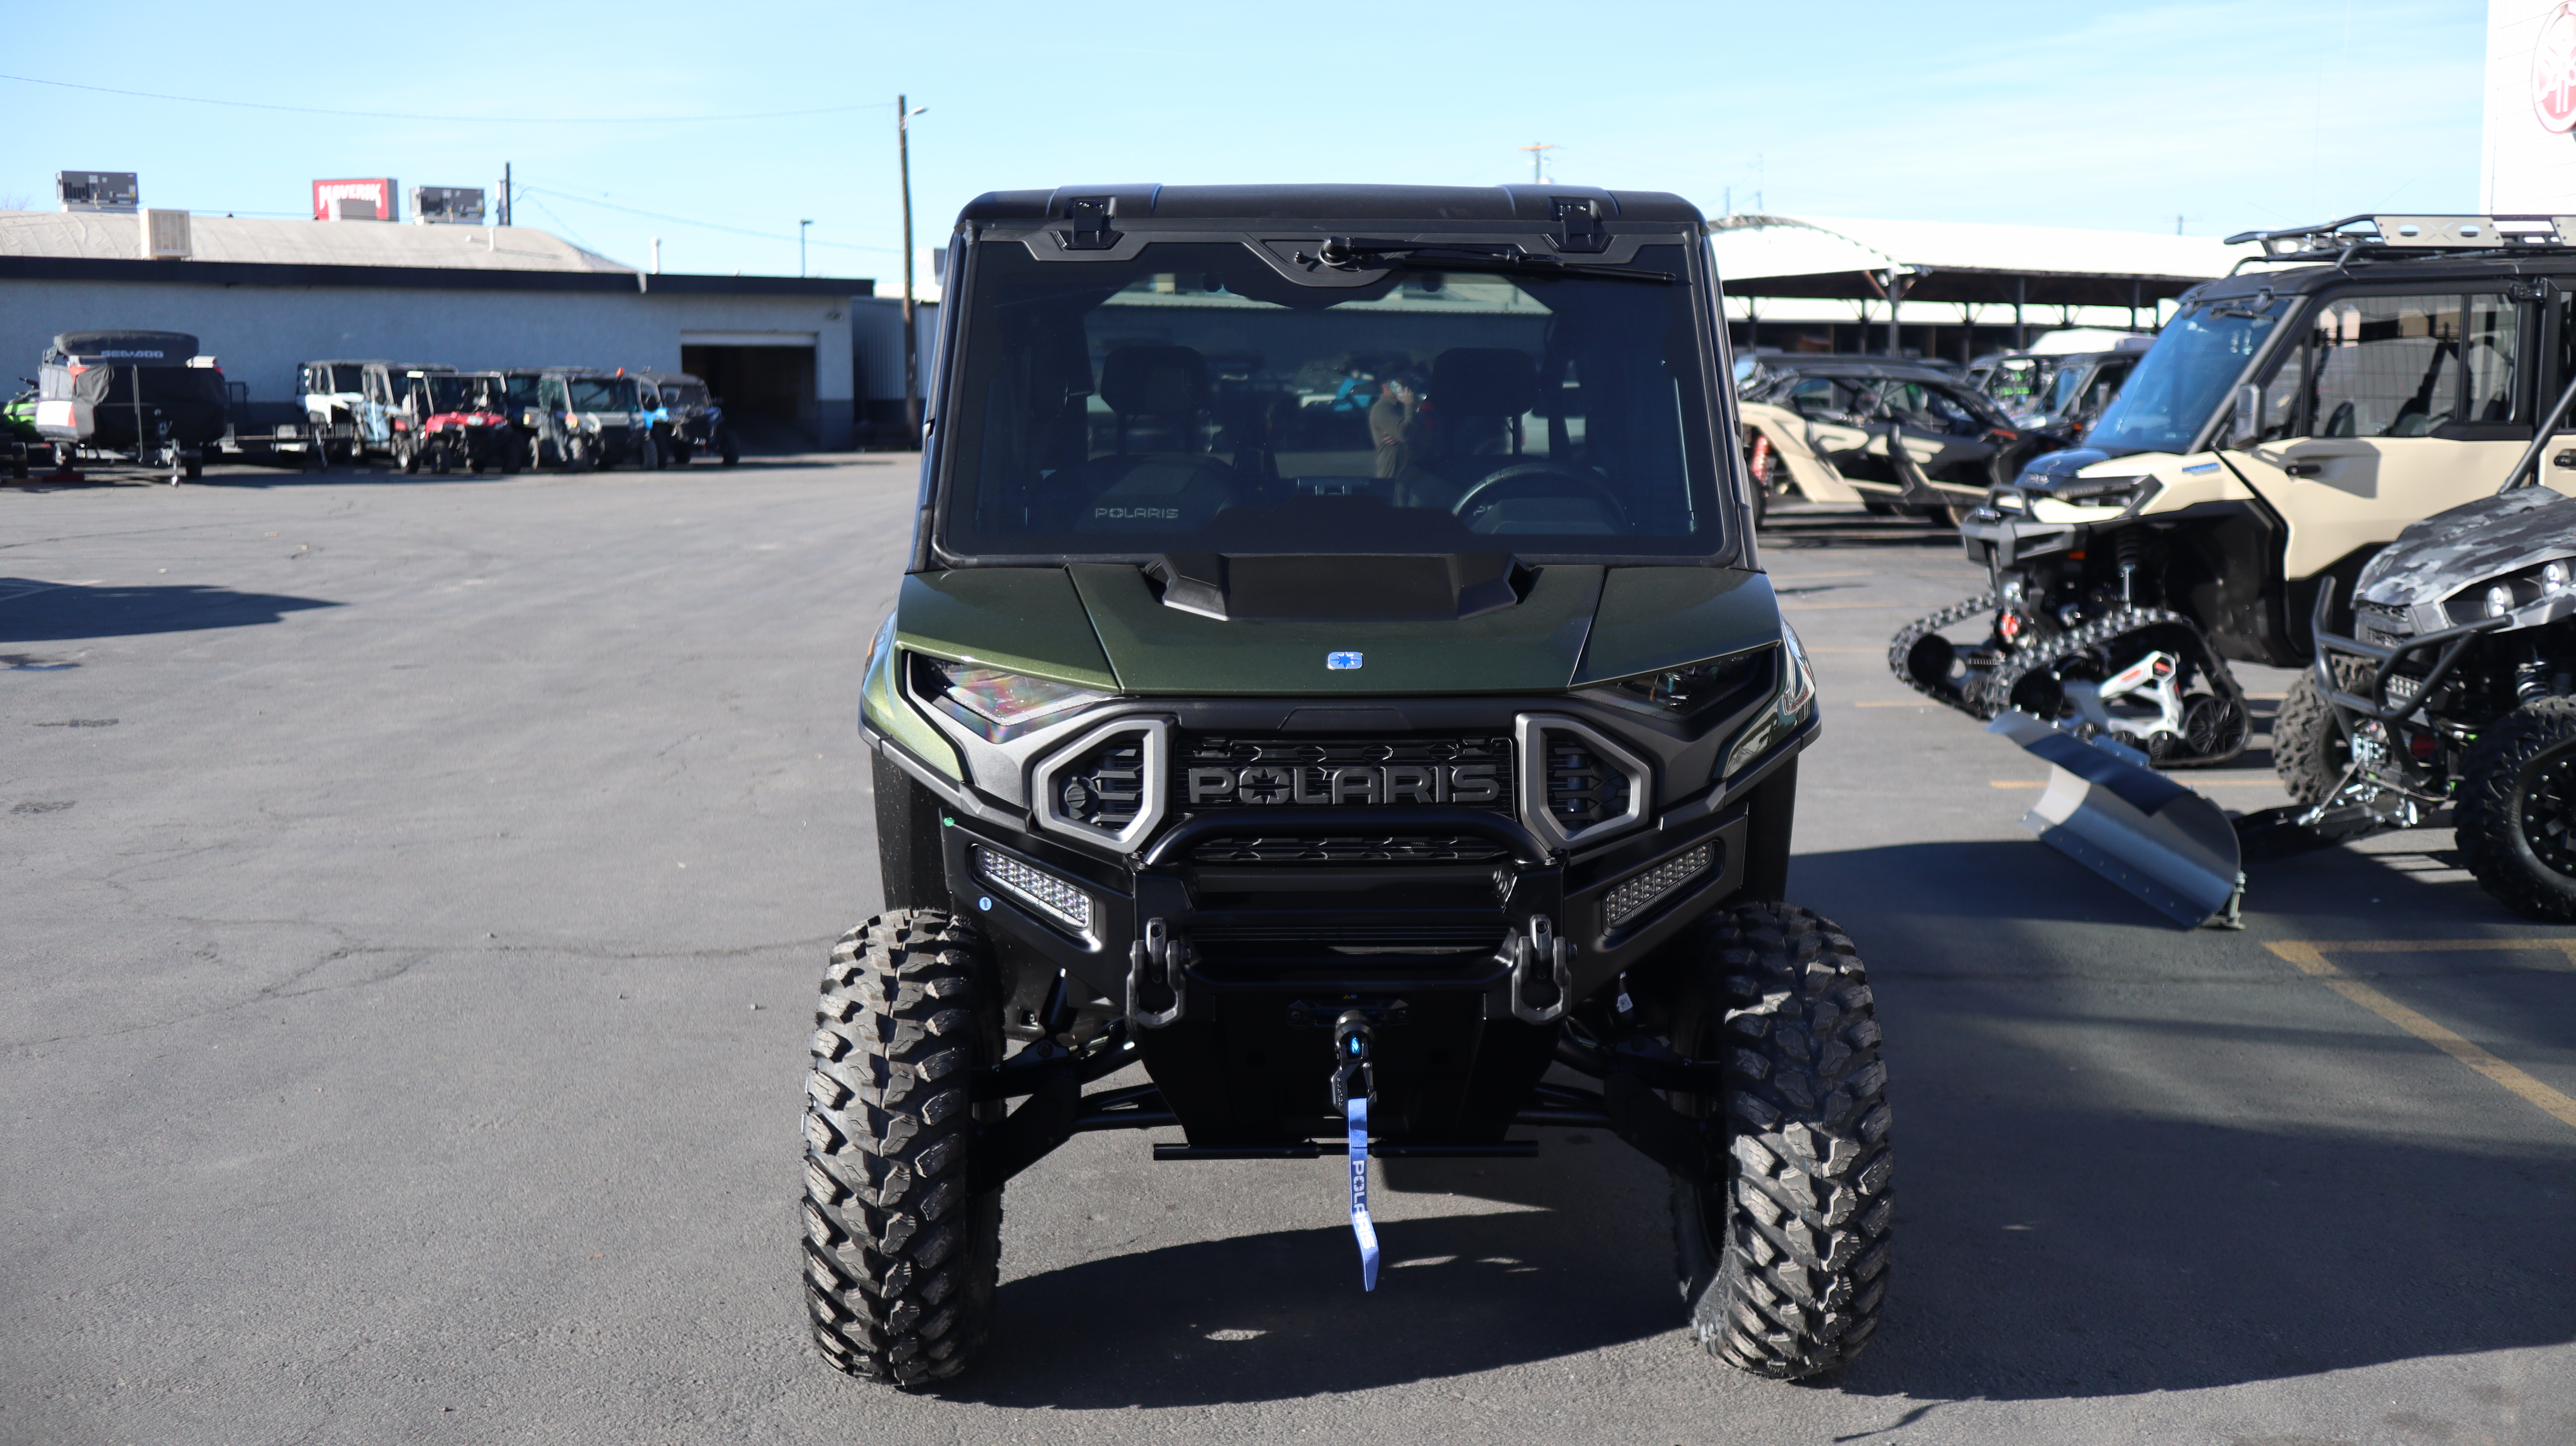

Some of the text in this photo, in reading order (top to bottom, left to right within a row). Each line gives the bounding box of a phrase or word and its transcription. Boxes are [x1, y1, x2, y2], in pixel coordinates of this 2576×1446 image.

[319, 183, 382, 211] MAVERIK
[1096, 508, 1179, 518] POLARIS
[1189, 766, 1500, 805] POLARIS
[1353, 1160, 1376, 1249] POLARIS
